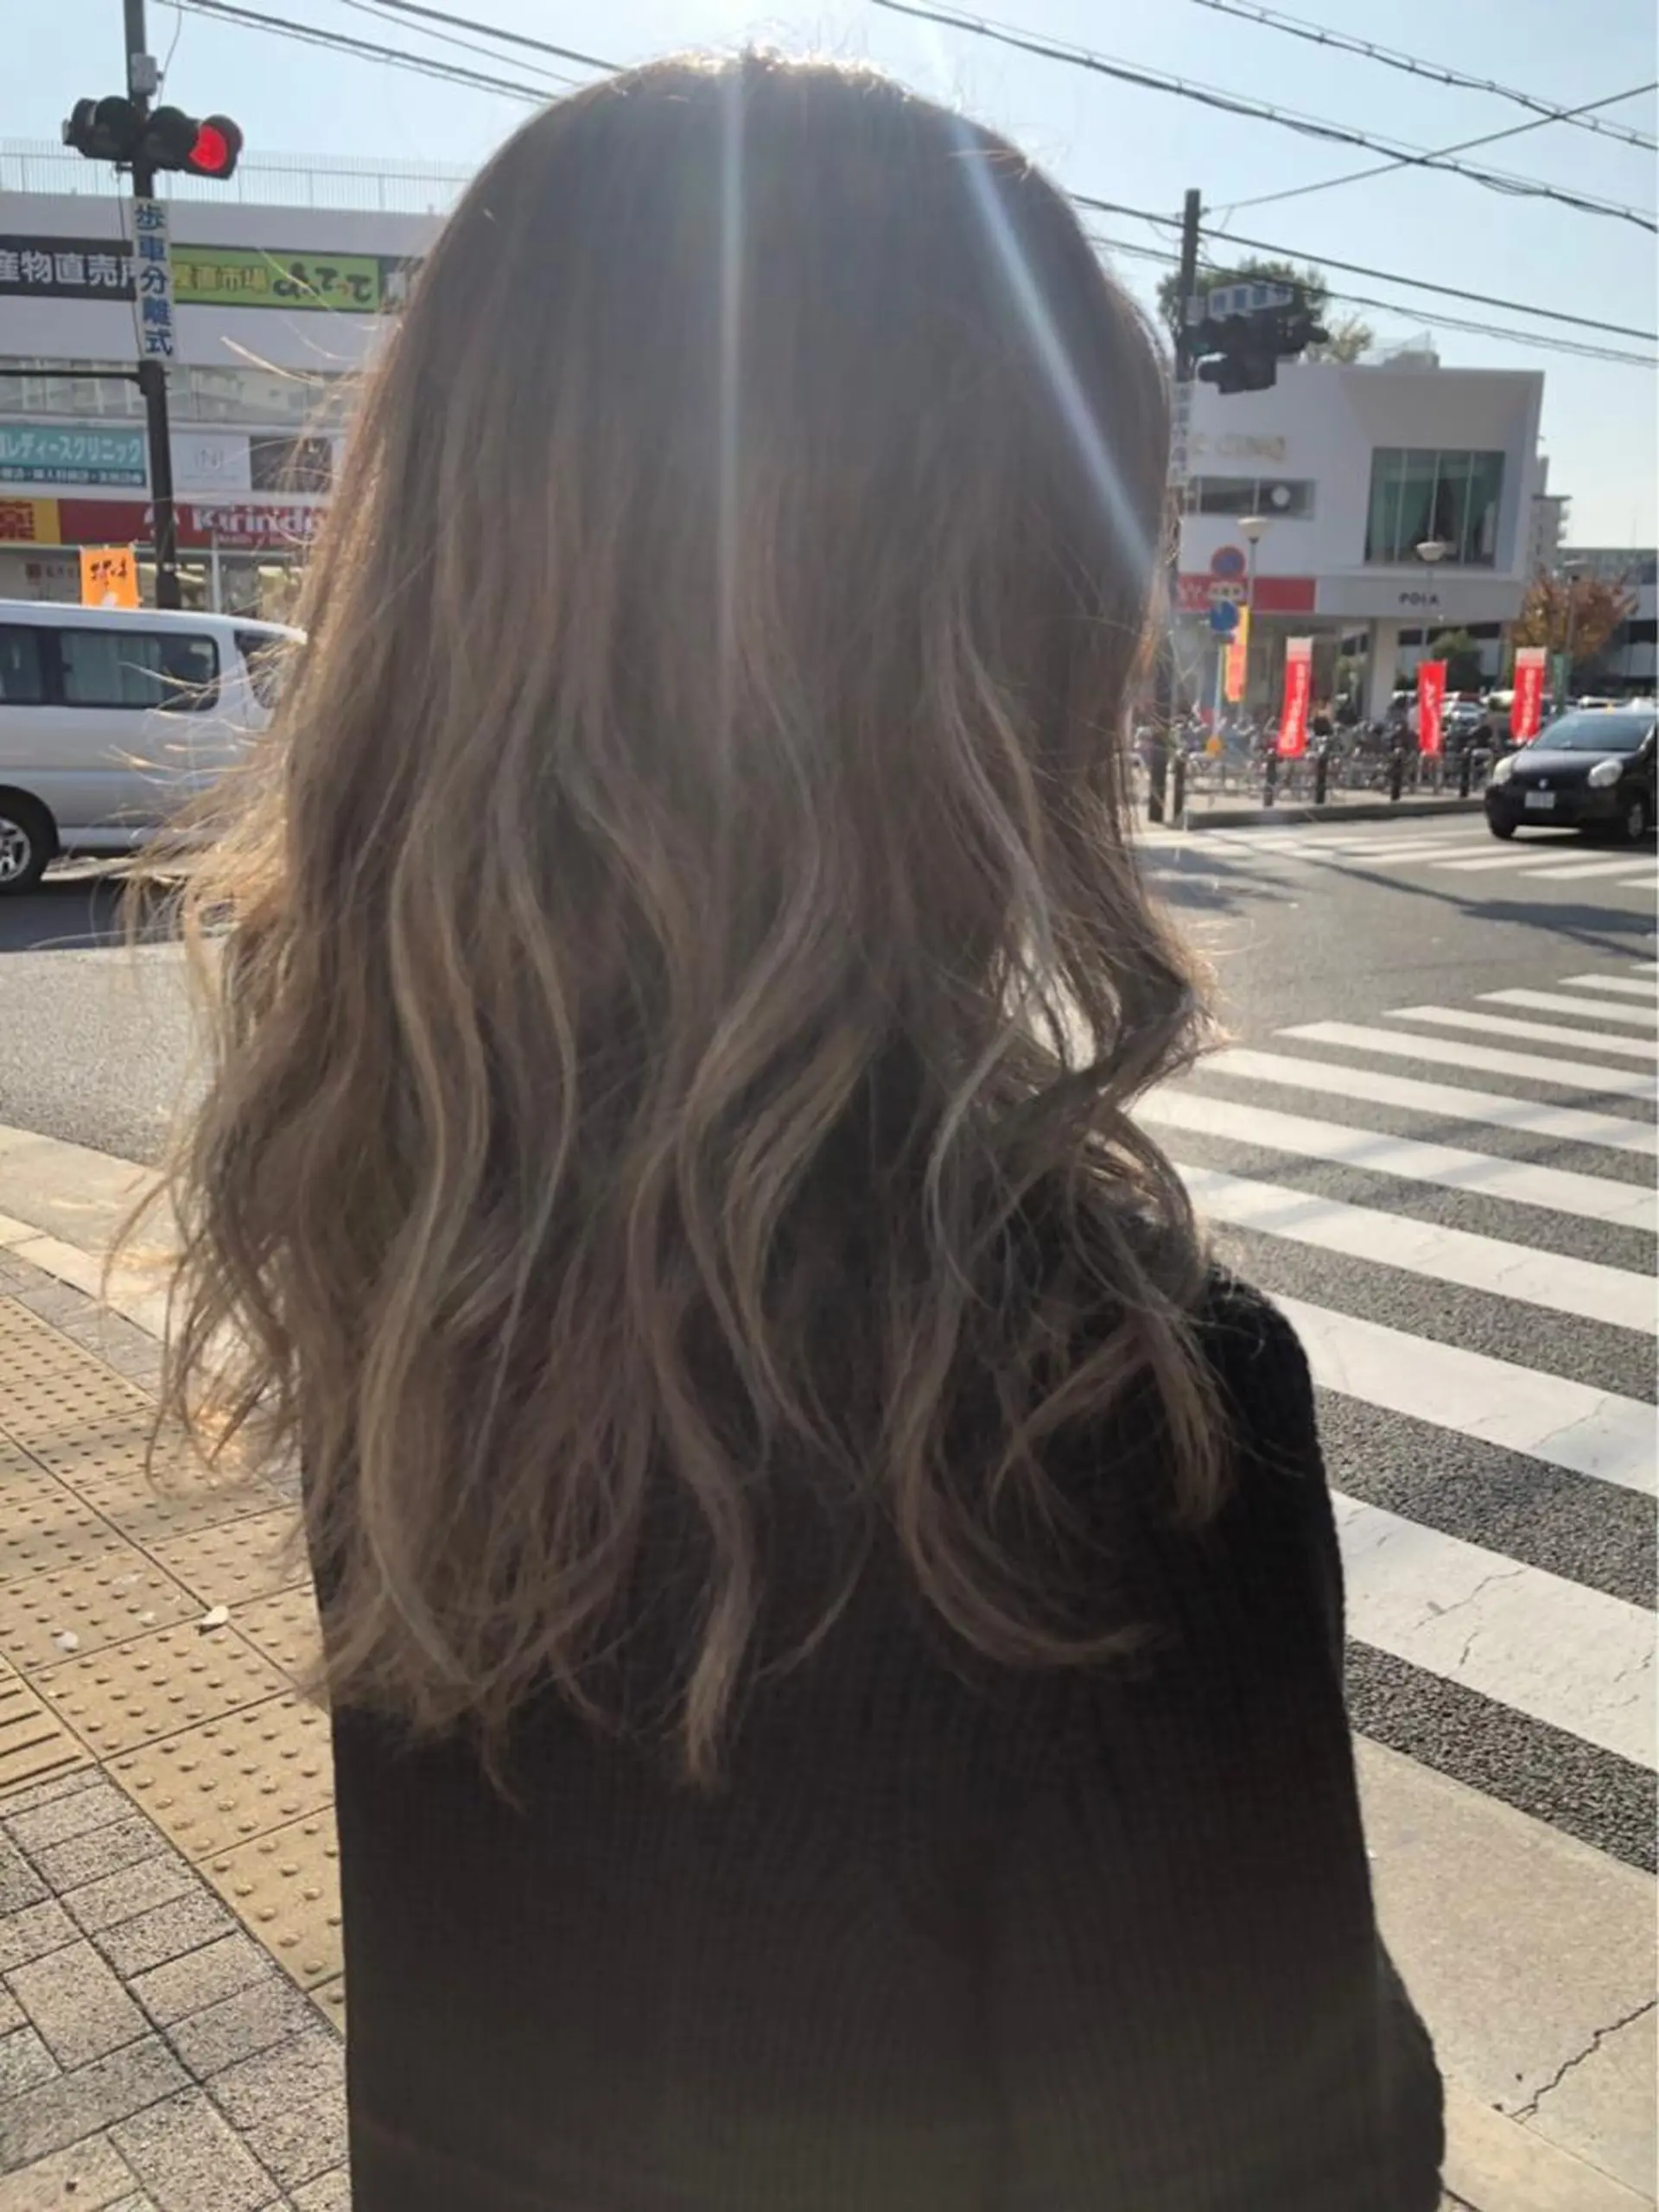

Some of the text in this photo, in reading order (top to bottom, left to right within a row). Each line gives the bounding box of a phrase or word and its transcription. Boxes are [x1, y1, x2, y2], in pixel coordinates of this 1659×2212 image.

[135, 203, 173, 356] 歩車分離式
[0, 432, 142, 464] レディースクリニック
